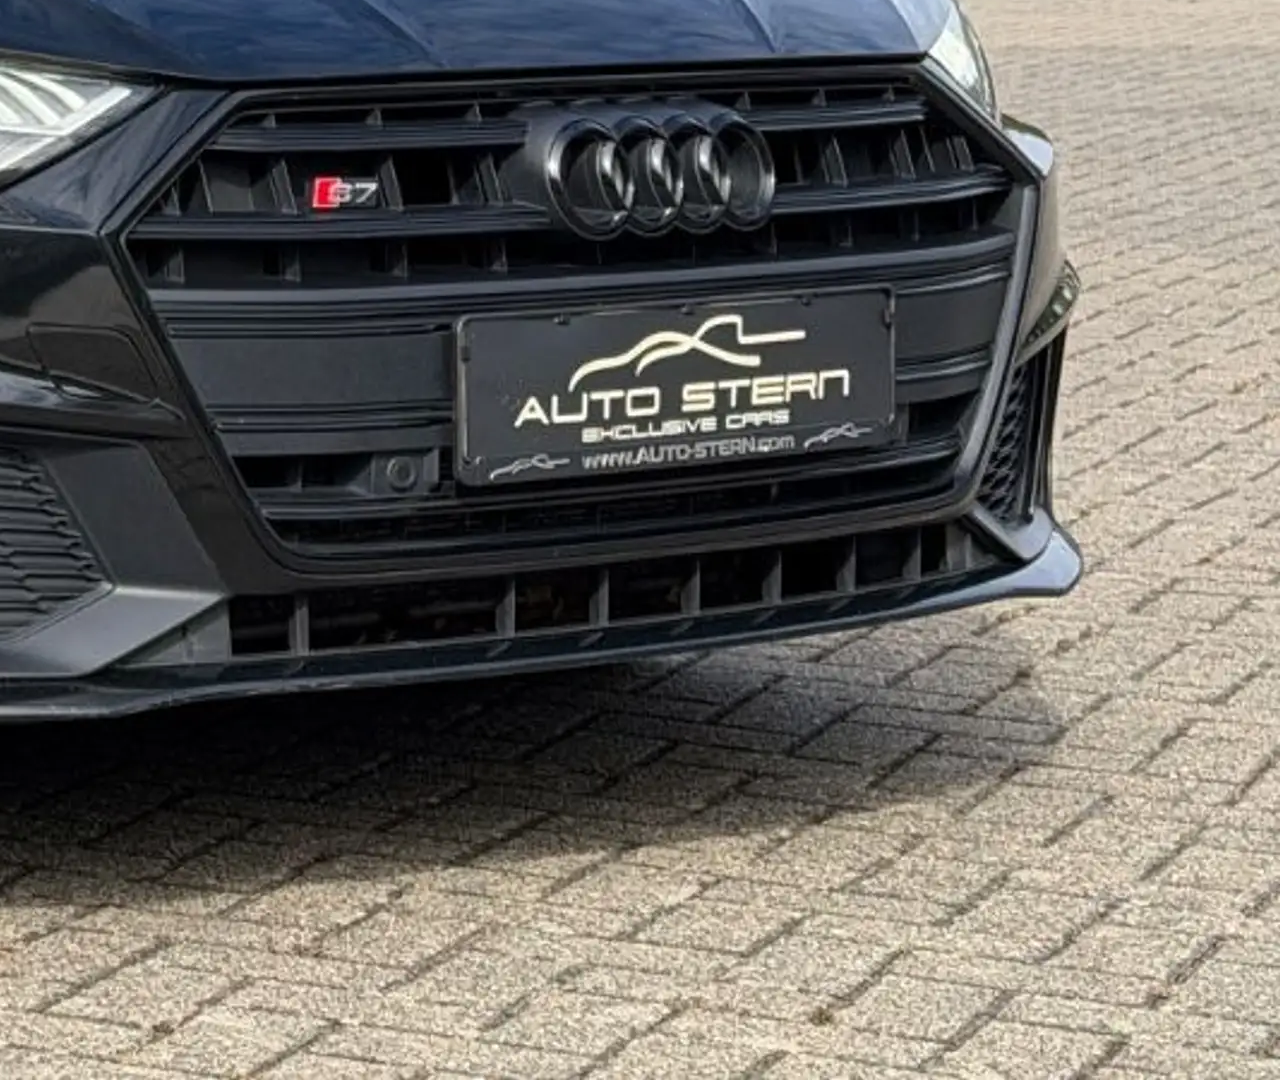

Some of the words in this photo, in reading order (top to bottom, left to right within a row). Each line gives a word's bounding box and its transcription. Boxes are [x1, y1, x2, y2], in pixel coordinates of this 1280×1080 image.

[513, 386, 661, 428] AUTO
[680, 369, 851, 413] STERN
[581, 416, 719, 444] EXCLUSIVE
[724, 409, 791, 429] CARS
[580, 433, 796, 471] www.AUTO-STERN.com
